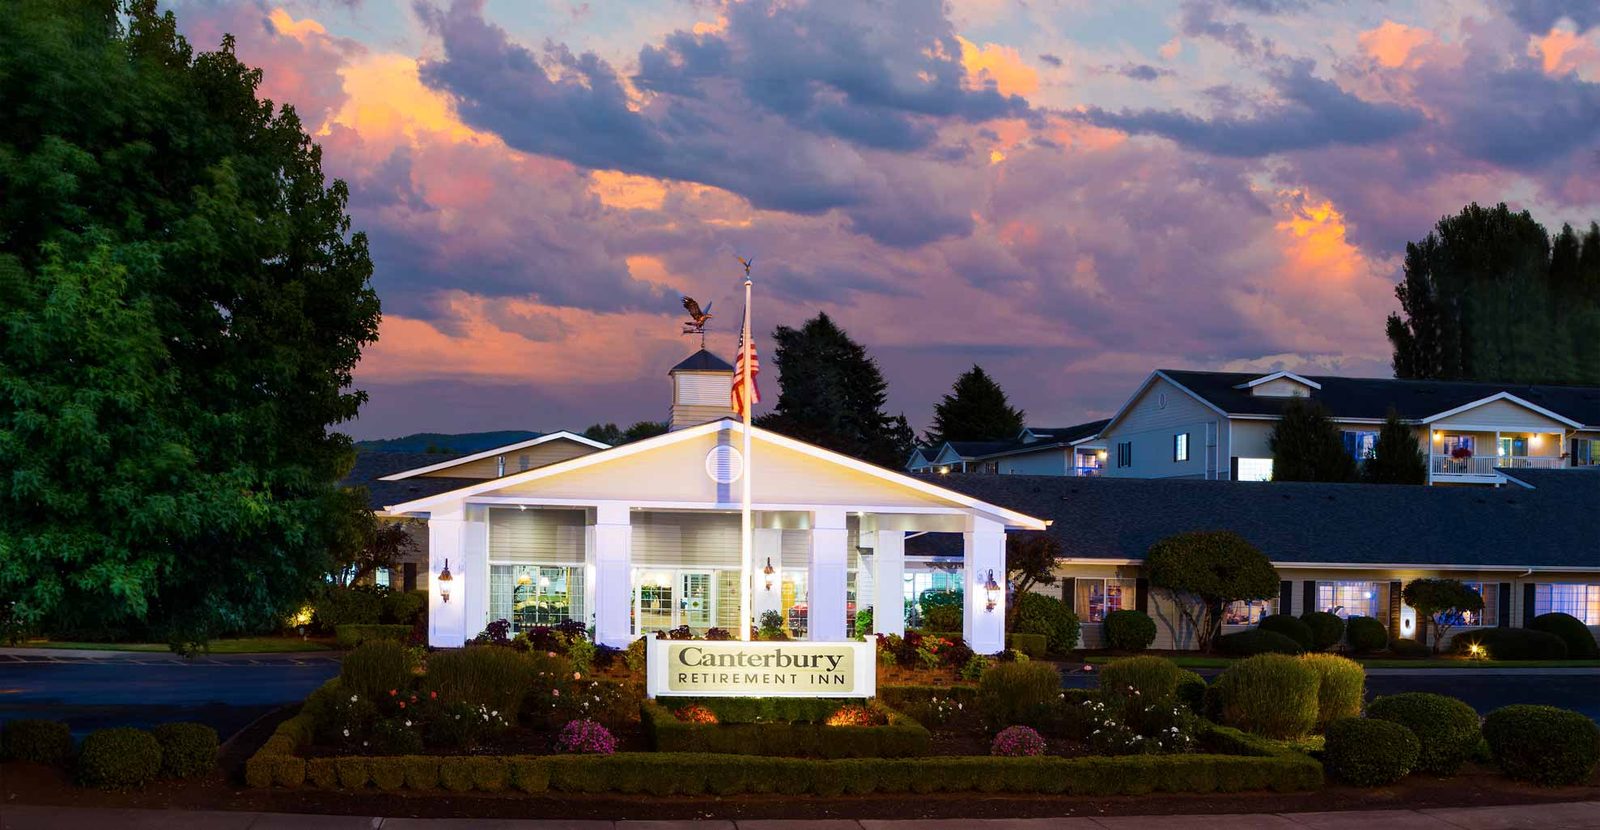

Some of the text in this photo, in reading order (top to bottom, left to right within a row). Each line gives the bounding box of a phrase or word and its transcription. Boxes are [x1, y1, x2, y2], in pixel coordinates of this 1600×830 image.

[679, 646, 845, 672] Canterbury
[678, 673, 845, 685] RETIREMENT INN
